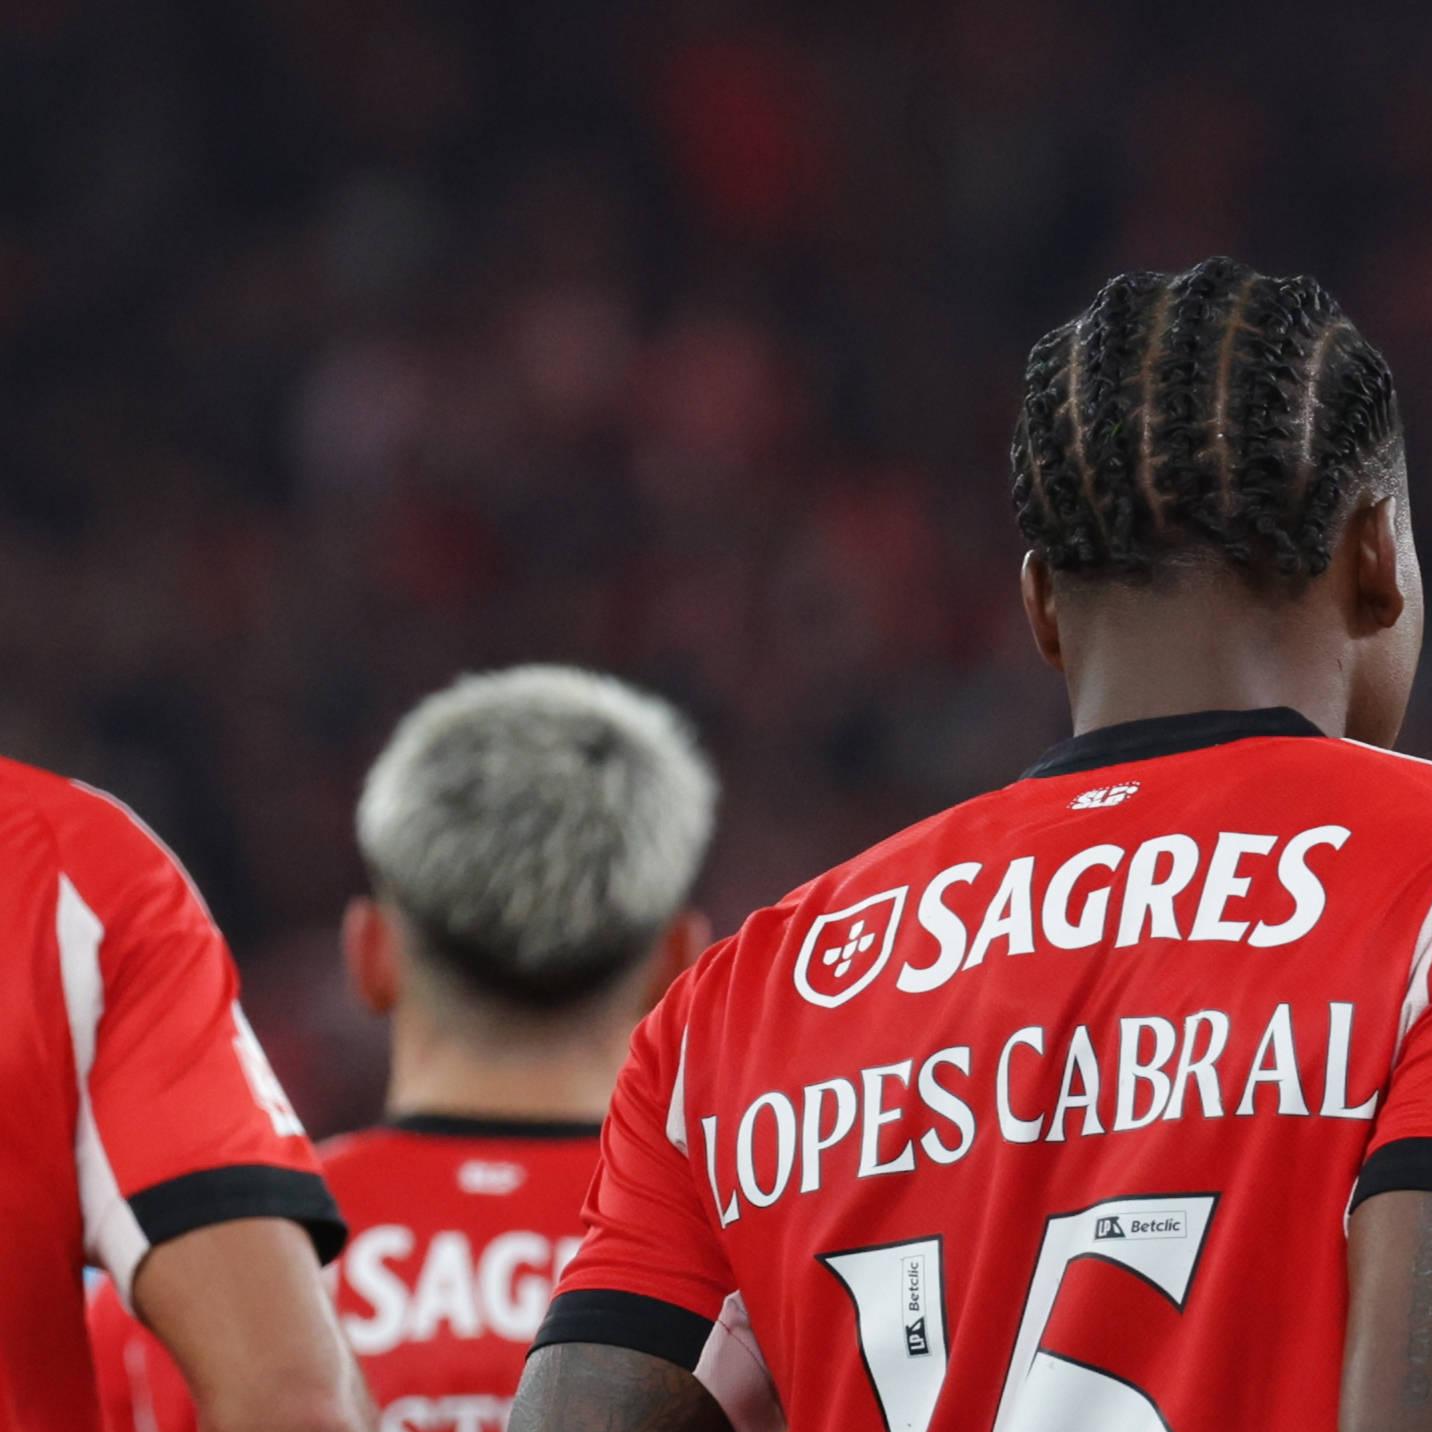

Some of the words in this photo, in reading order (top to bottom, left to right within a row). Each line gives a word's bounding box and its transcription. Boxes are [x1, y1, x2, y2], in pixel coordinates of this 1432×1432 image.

[897, 825, 1352, 993] SAGRES
[701, 1047, 976, 1228] LOPES
[996, 1002, 1379, 1143] CABRAL
[343, 1224, 583, 1355] SAG
[907, 1261, 920, 1311] Betclic
[1131, 1218, 1181, 1233] Betclic
